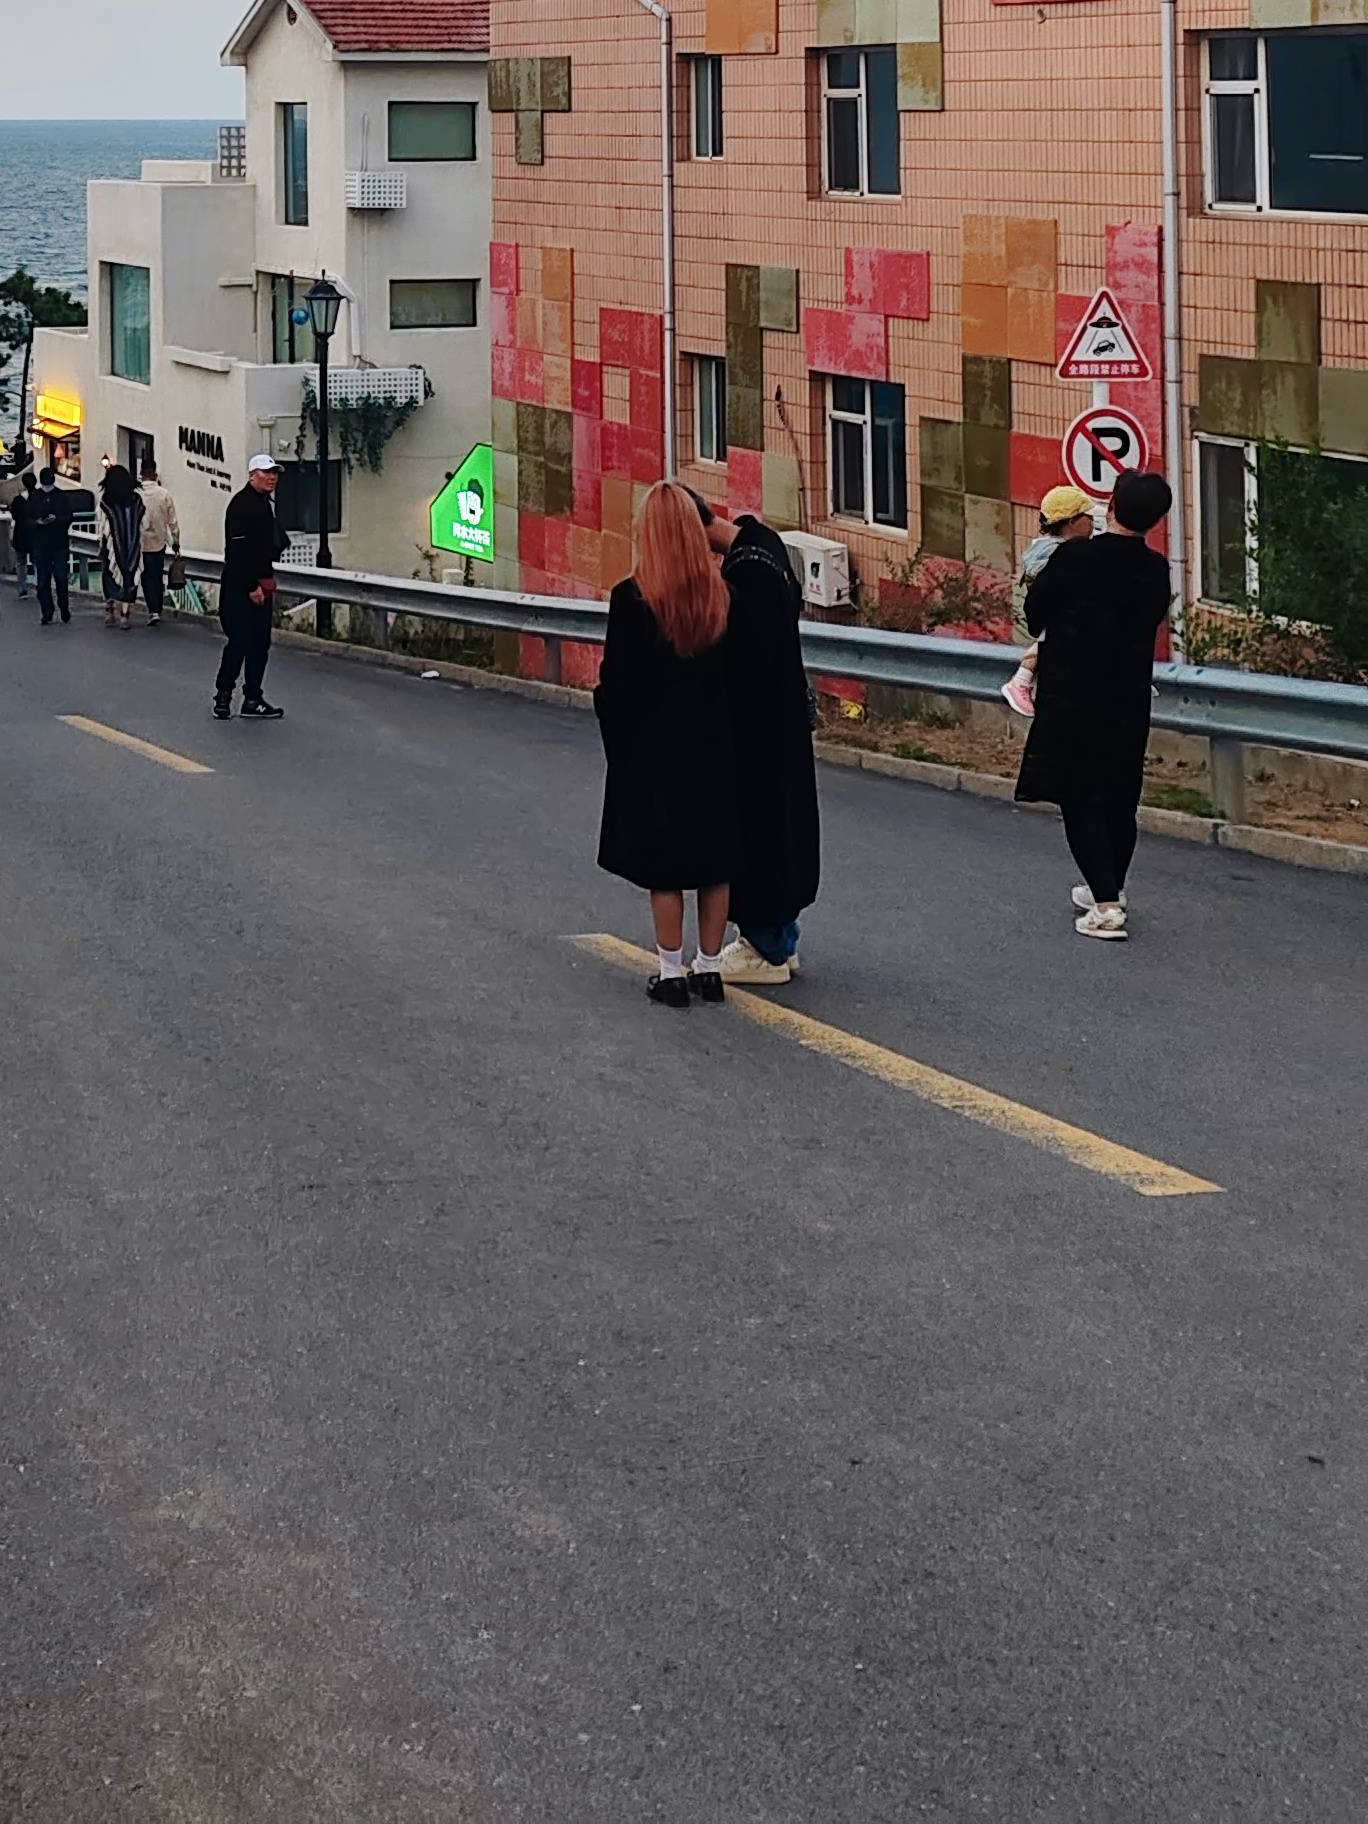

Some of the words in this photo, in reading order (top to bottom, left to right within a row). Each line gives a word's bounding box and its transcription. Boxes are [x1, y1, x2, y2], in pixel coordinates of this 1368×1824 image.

[1068, 363, 1141, 376] 全路段禁止停车
[1091, 427, 1131, 482] P
